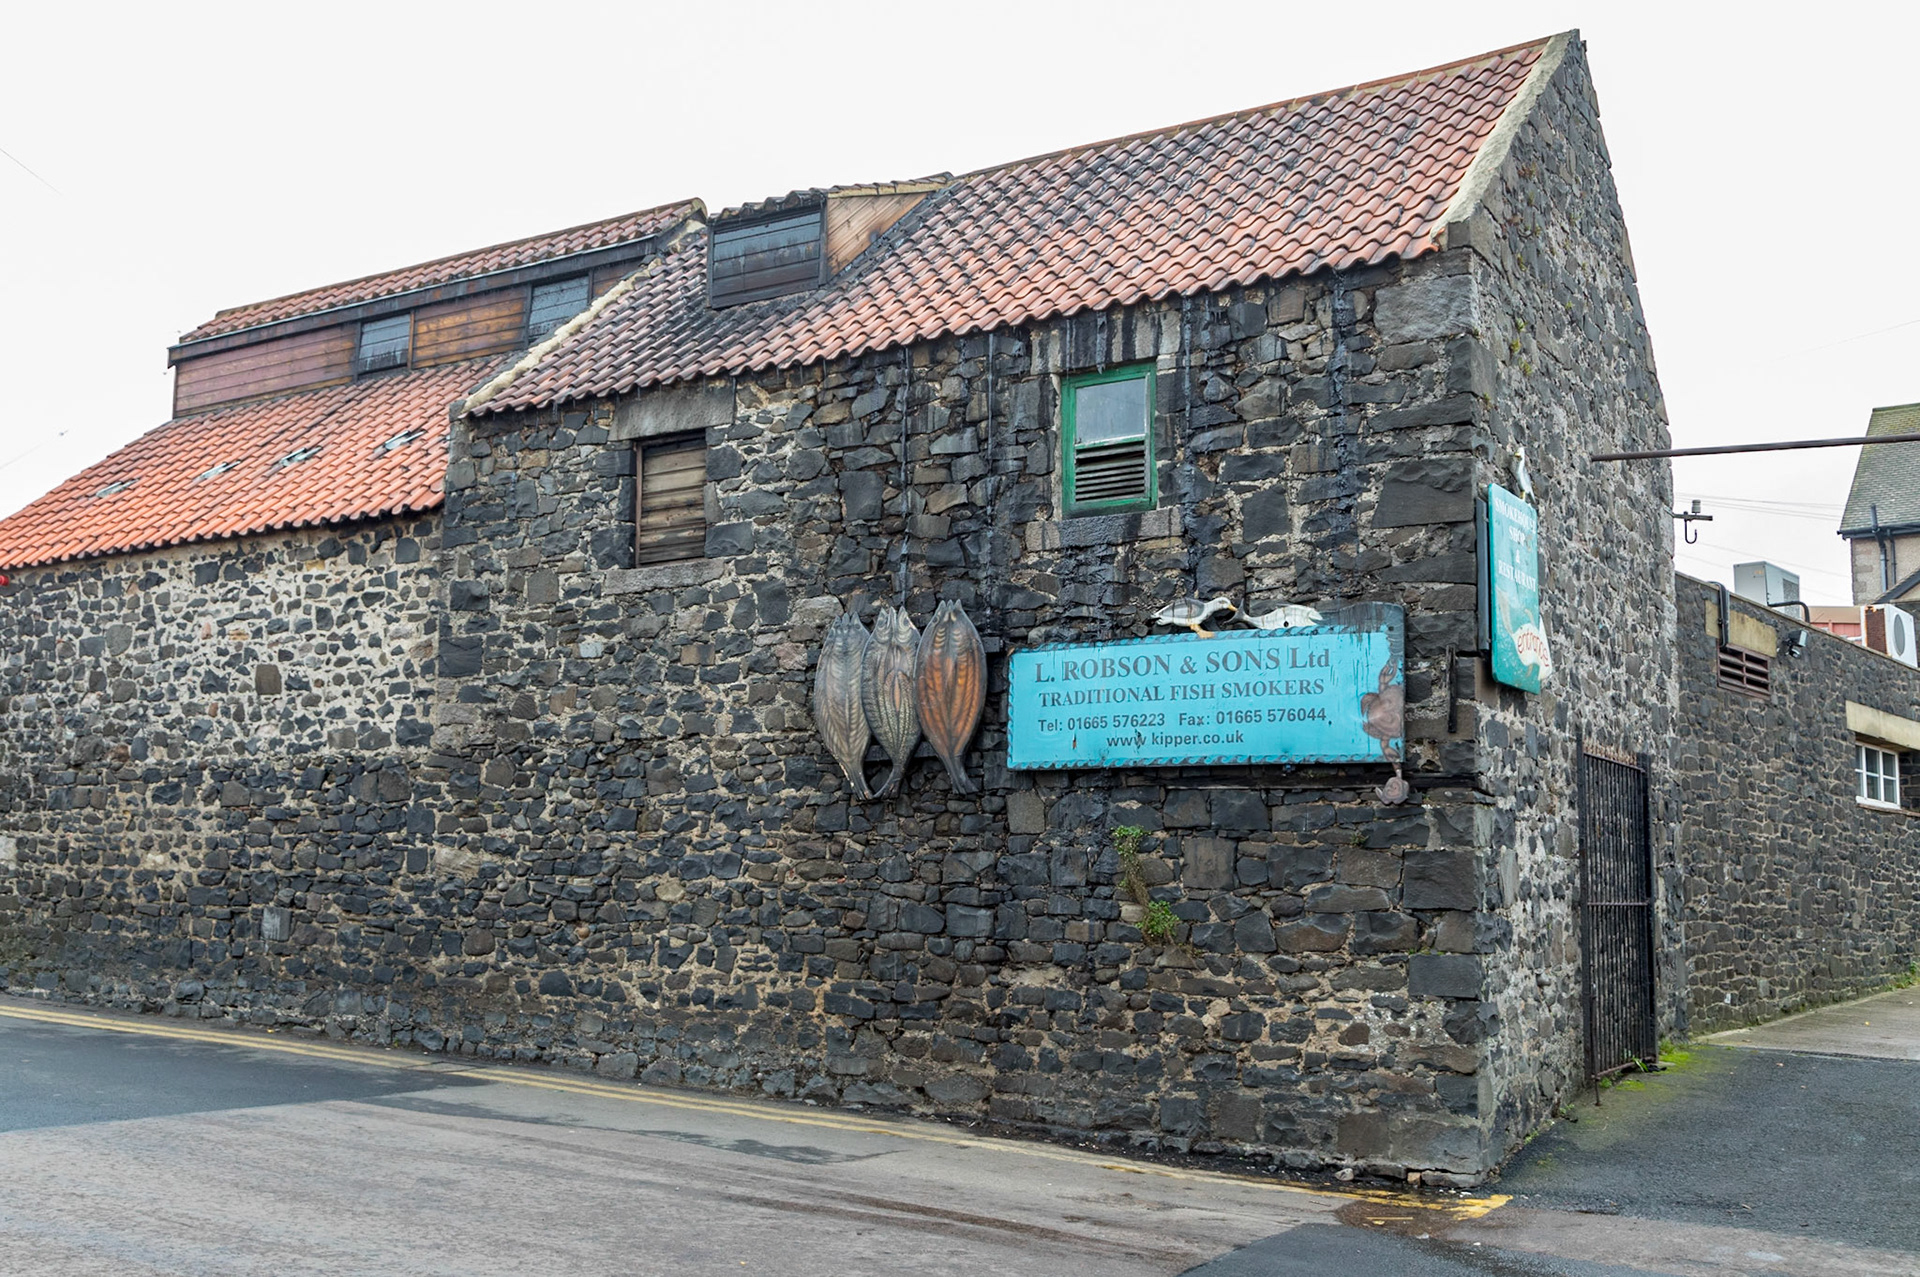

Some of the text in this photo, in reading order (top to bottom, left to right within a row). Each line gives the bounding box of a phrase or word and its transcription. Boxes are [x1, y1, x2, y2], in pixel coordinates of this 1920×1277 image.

[1509, 525, 1525, 546] SHOP
[1498, 559, 1536, 592] RESTAURANT
[1517, 630, 1550, 667] entrance
[1035, 647, 1330, 683] L. ROBSON & SONS Ltd
[1039, 678, 1325, 707] TRADITIONAL FISH SMOKERS
[1038, 707, 1327, 732] Tel: 01665 576223 Fax: 01665 576044
